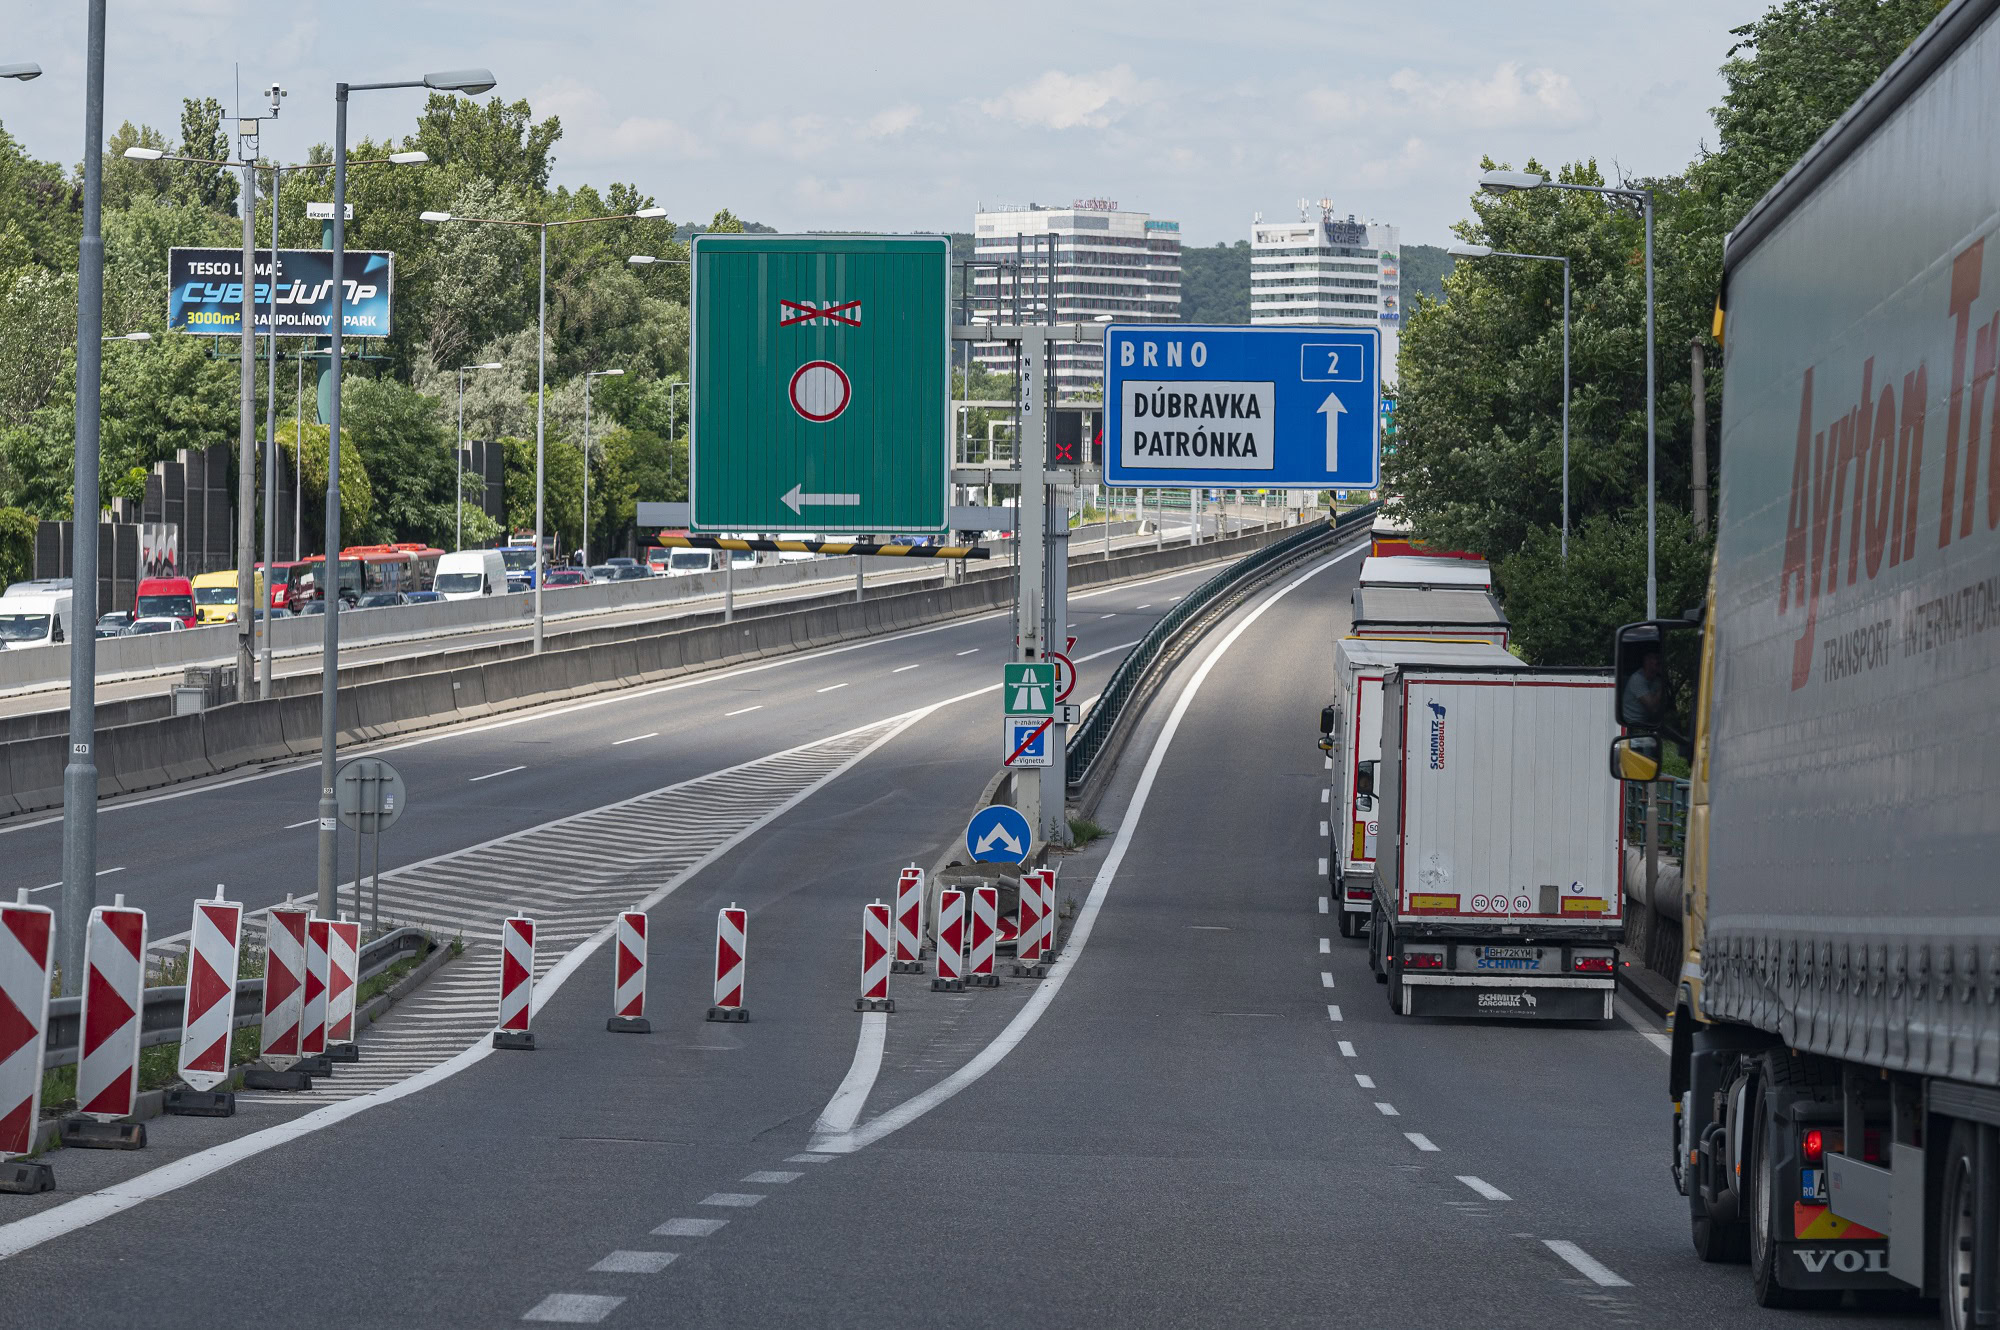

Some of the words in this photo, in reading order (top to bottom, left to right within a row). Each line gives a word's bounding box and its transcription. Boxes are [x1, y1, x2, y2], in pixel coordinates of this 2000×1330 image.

[187, 262, 230, 276] TESCO
[234, 260, 282, 277] LMAČ
[253, 312, 334, 326] RAMPOLÍNOV
[343, 315, 377, 327] PARK
[780, 300, 862, 327] BRNO
[1121, 341, 1208, 368] BRNO
[1327, 352, 1339, 374] 2
[1134, 386, 1261, 419] DÚBRAVKA
[1134, 425, 1258, 458] PATRÓNKA
[1778, 355, 1928, 691] Ayrton
[1823, 618, 1892, 683] TRANSPORT
[1904, 575, 2000, 658] INTERNATION
[1063, 707, 1070, 722] E
[75, 744, 87, 753] 40
[1430, 720, 1439, 770] SCHMITZ
[1475, 899, 1486, 908] 50
[1494, 899, 1505, 908] 70
[1516, 900, 1528, 909] 80
[1490, 948, 1502, 957] BH
[1478, 959, 1540, 970] SCHMITZ
[1802, 1186, 1814, 1197] RO
